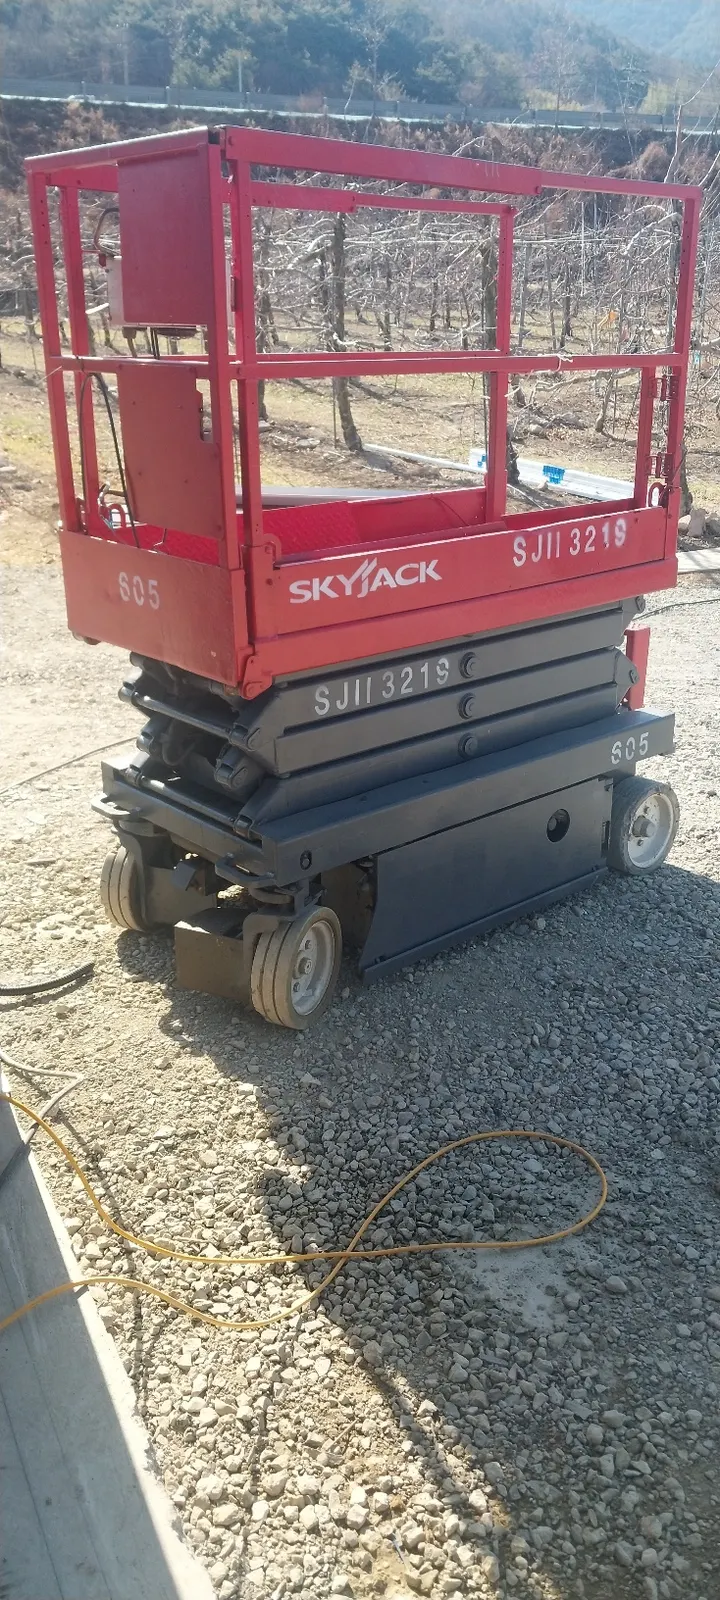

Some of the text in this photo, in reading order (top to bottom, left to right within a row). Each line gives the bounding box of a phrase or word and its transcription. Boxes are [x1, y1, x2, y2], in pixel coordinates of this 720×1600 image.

[569, 518, 627, 556] 3219
[289, 557, 443, 604] SKYJACK
[382, 657, 449, 698] 3219
